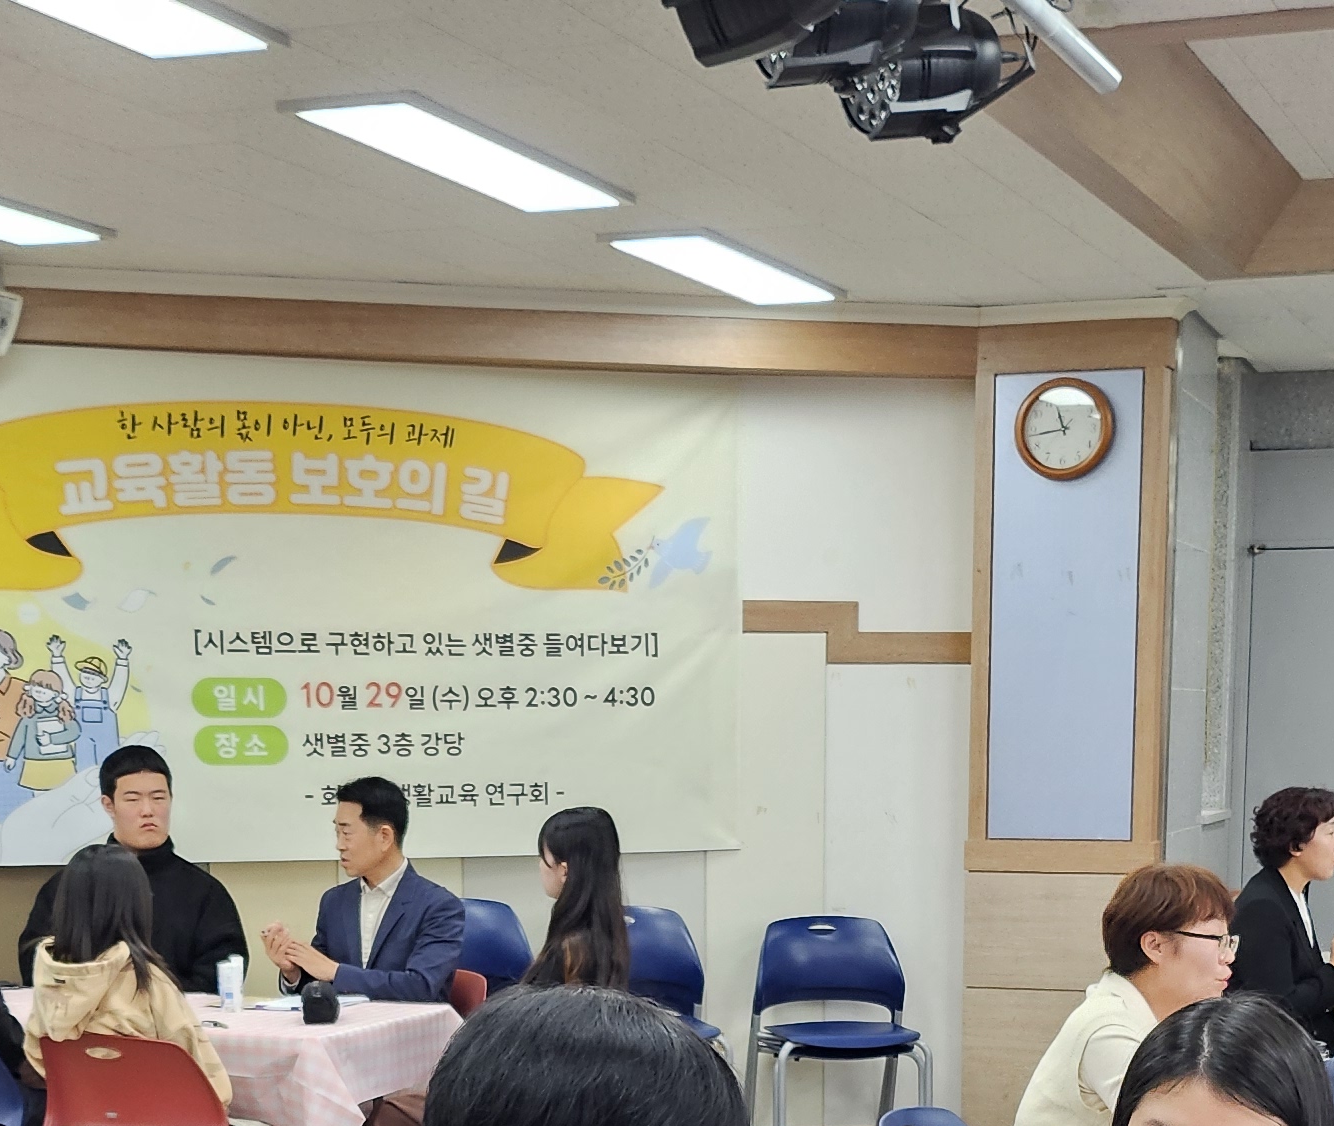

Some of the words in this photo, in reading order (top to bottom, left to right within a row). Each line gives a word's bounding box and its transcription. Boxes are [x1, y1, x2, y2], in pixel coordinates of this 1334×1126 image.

[116, 410, 143, 441] 한
[151, 410, 226, 440] 사람의
[236, 409, 272, 442] 몫이
[282, 413, 333, 443] 아닌,
[342, 415, 396, 446] 모두의
[405, 422, 456, 448] 과제
[54, 450, 276, 516] 교육활동
[289, 451, 447, 517] 보호의
[460, 464, 509, 525] 길
[193, 629, 321, 658] [시스템으로
[324, 630, 417, 658] 구현하고
[422, 632, 466, 658] 있는
[471, 632, 538, 659] 샛별중
[543, 632, 659, 659] 들여다보기]
[300, 682, 359, 710] 10월
[365, 682, 426, 710] 29일
[431, 685, 470, 711] (수)
[474, 686, 520, 710] 오후
[525, 687, 578, 708] 2:30
[602, 687, 655, 708] 4:30
[302, 732, 370, 758] 샛별중
[377, 732, 415, 758] 3층
[420, 732, 465, 758] 강당
[484, 782, 549, 806] 연구회
